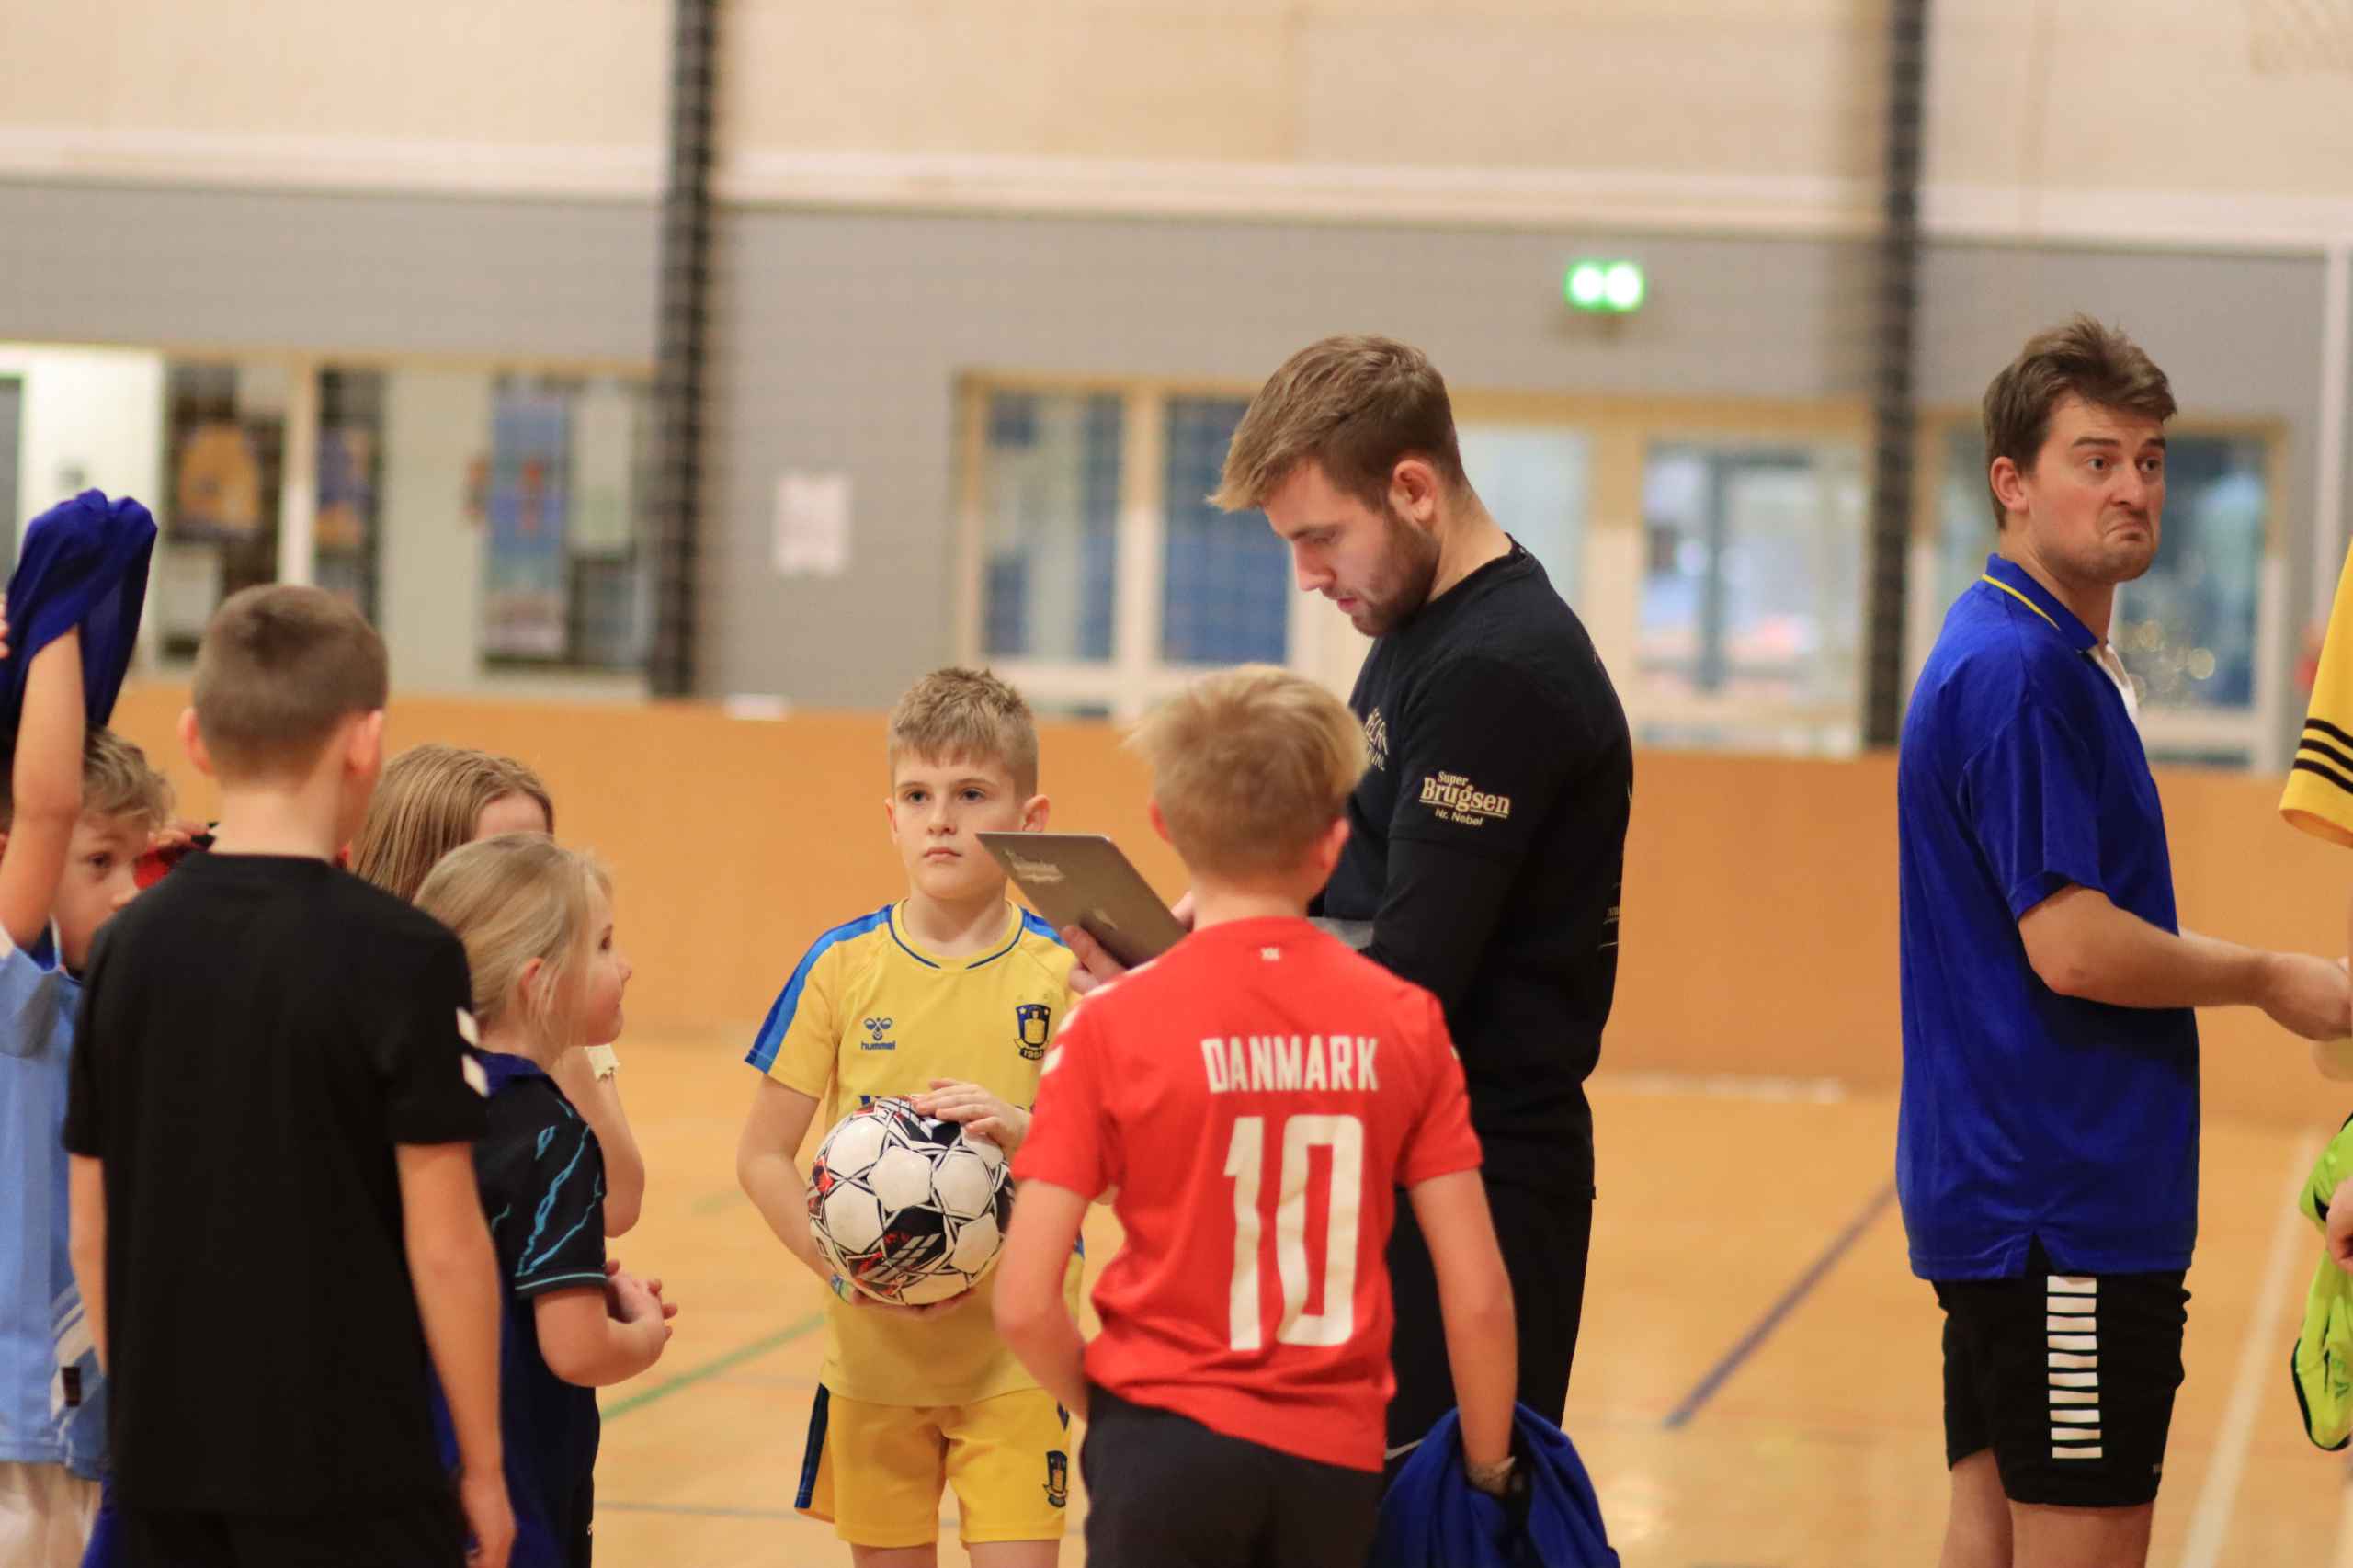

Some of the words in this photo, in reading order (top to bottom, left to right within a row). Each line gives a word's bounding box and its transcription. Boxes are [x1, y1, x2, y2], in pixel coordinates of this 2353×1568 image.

[1437, 770, 1470, 787] Super
[1420, 777, 1511, 815] Brugsen
[1435, 809, 1449, 821] Nr.
[1451, 812, 1484, 825] Nebel
[860, 1040, 897, 1051] hummel
[1200, 1036, 1380, 1094] DANMARK
[1223, 1113, 1364, 1351] 10
